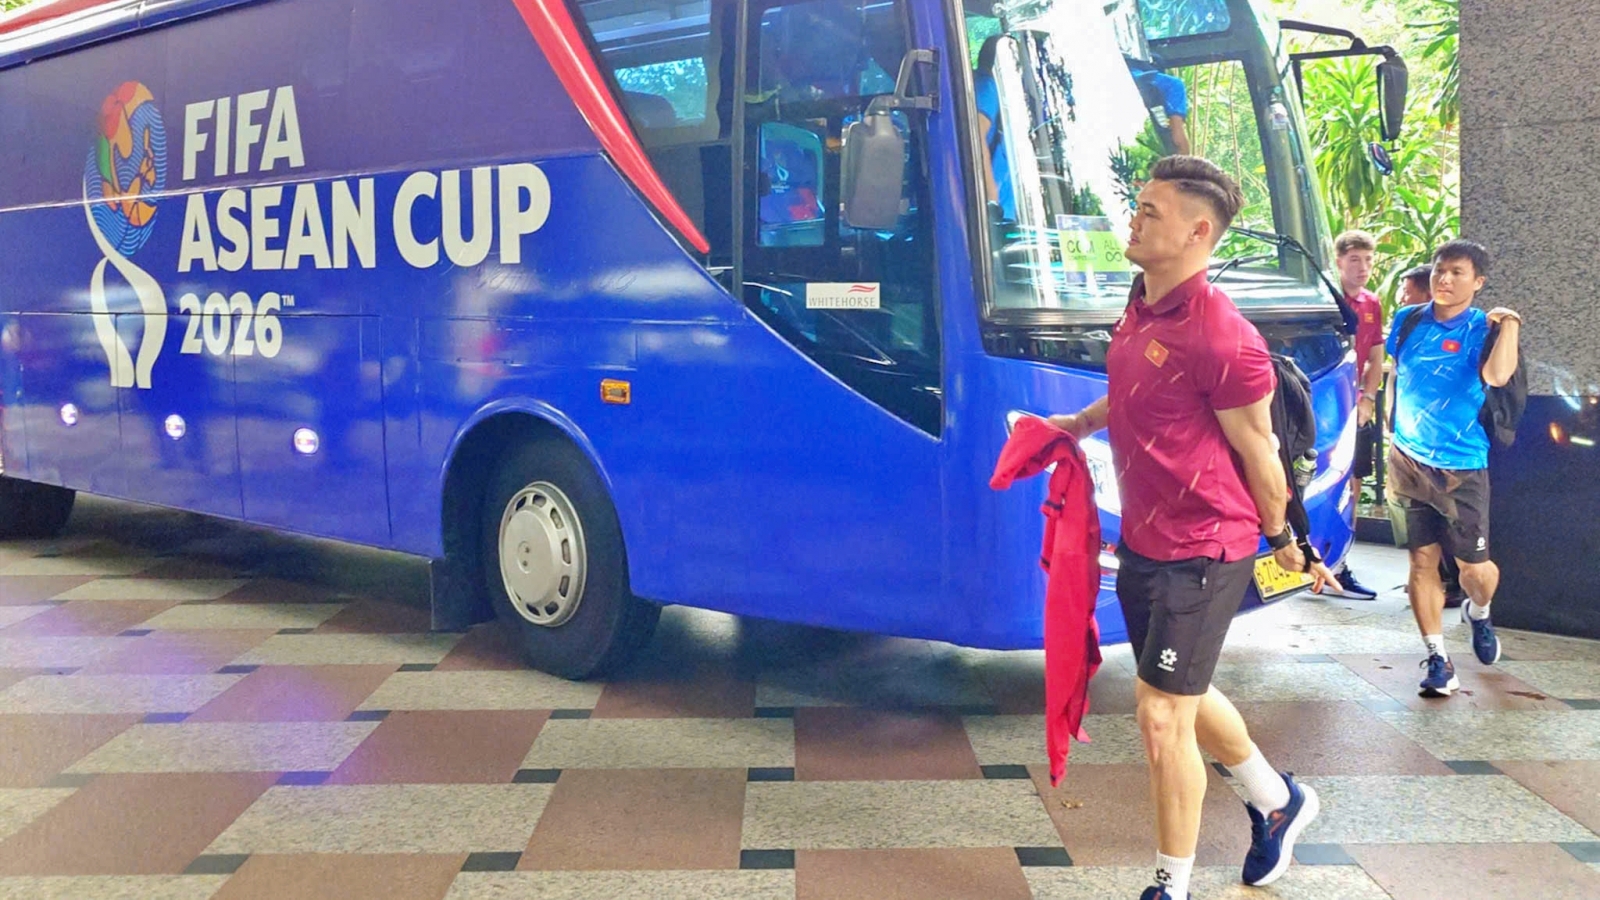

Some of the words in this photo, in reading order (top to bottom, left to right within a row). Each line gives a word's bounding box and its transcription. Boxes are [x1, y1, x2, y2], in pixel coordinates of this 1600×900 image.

[182, 85, 305, 181] FIFA
[177, 177, 376, 273] ASEAN
[392, 162, 551, 269] CUP
[809, 297, 875, 307] WHITEHORSE
